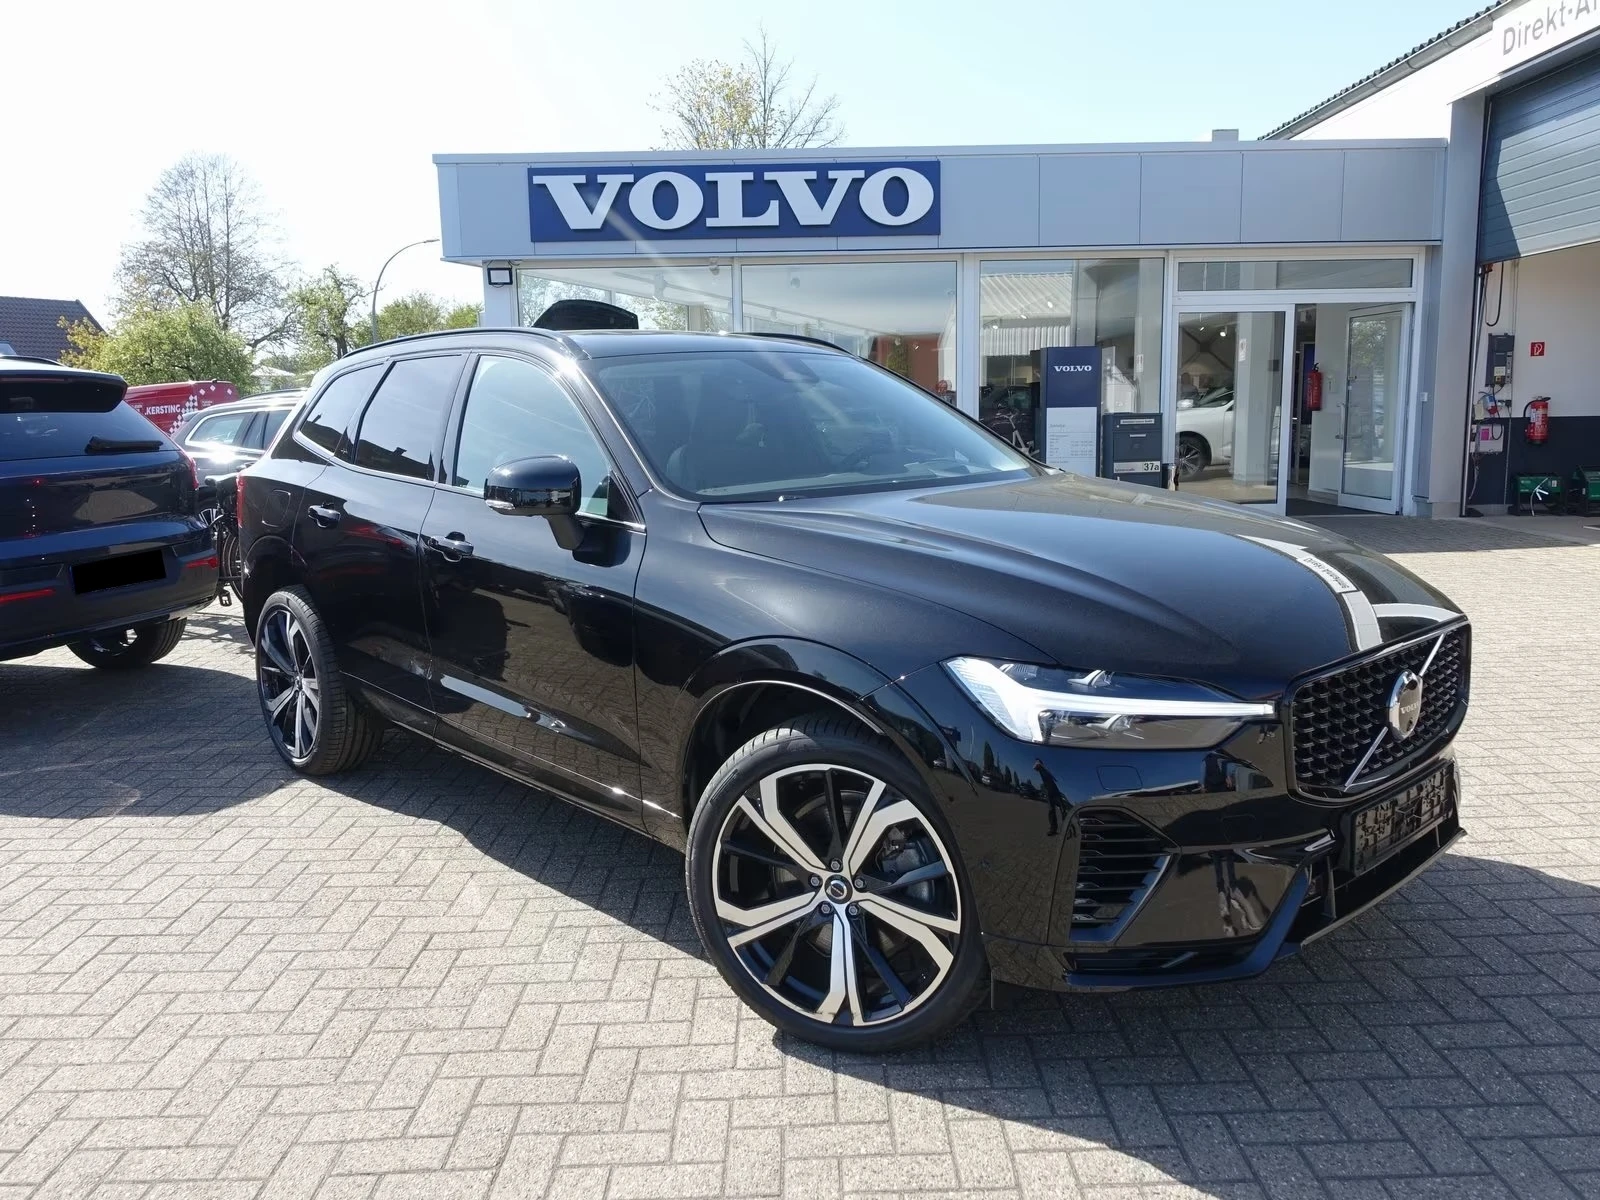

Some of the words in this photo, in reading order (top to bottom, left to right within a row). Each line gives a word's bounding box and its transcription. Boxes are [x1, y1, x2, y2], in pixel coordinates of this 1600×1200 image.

[1503, 0, 1598, 56] Direkt-A
[532, 167, 934, 230] VOLVO
[1053, 364, 1093, 373] VOLVO
[1143, 462, 1160, 471] 37a
